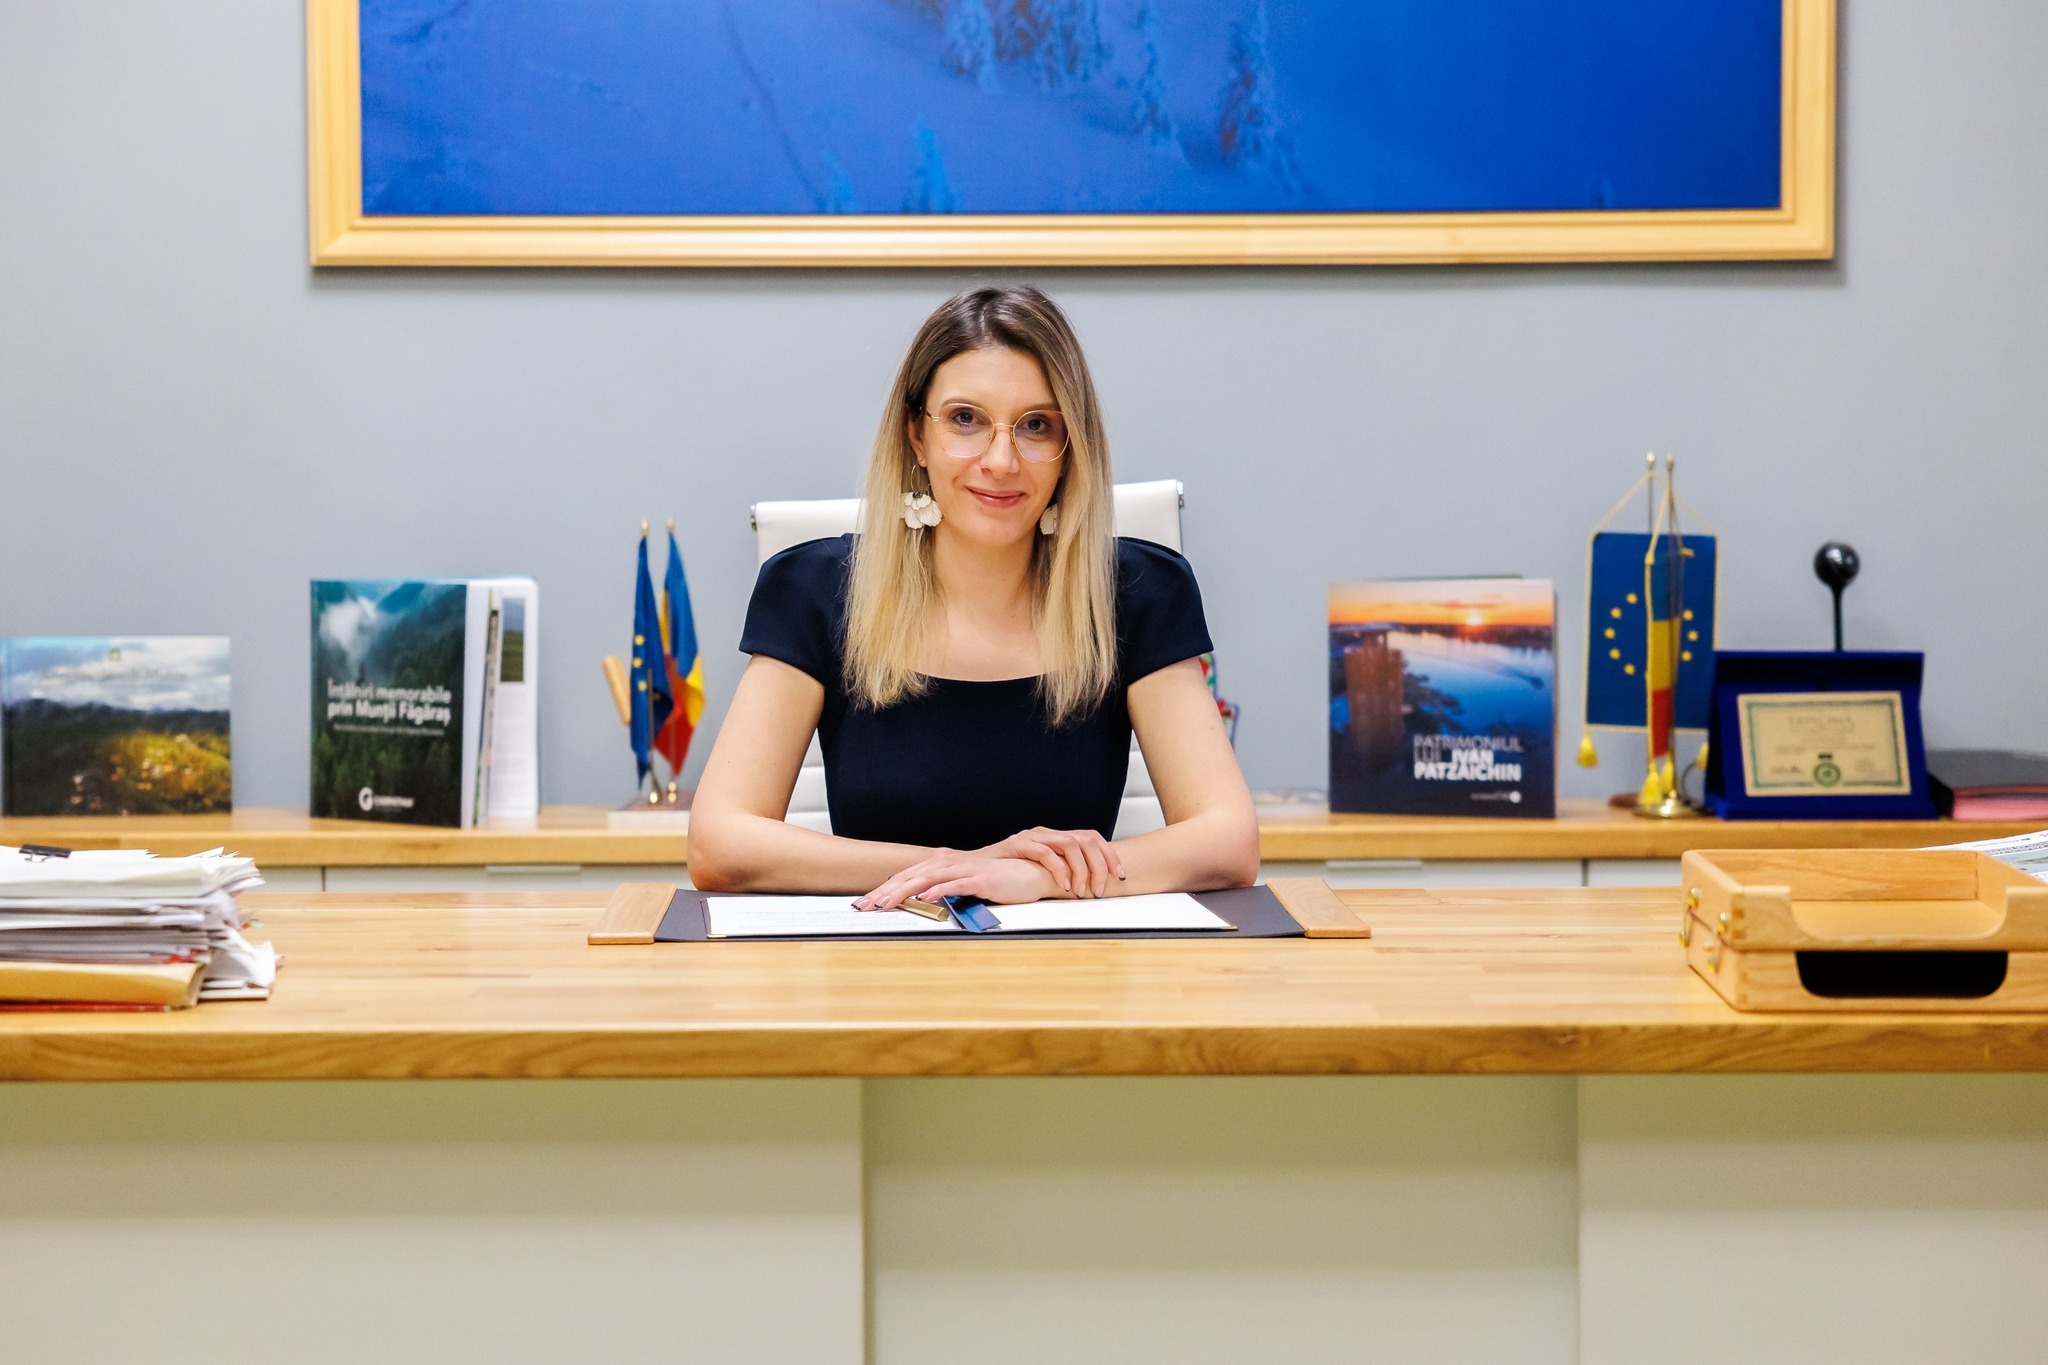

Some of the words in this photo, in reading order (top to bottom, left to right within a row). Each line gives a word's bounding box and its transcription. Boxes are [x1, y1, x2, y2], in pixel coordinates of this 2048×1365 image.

[376, 684, 452, 703] memorabile
[1414, 734, 1524, 752] PATRIMONIUL
[1451, 749, 1494, 766] IVAN
[1414, 762, 1522, 781] PATZAICHIN
